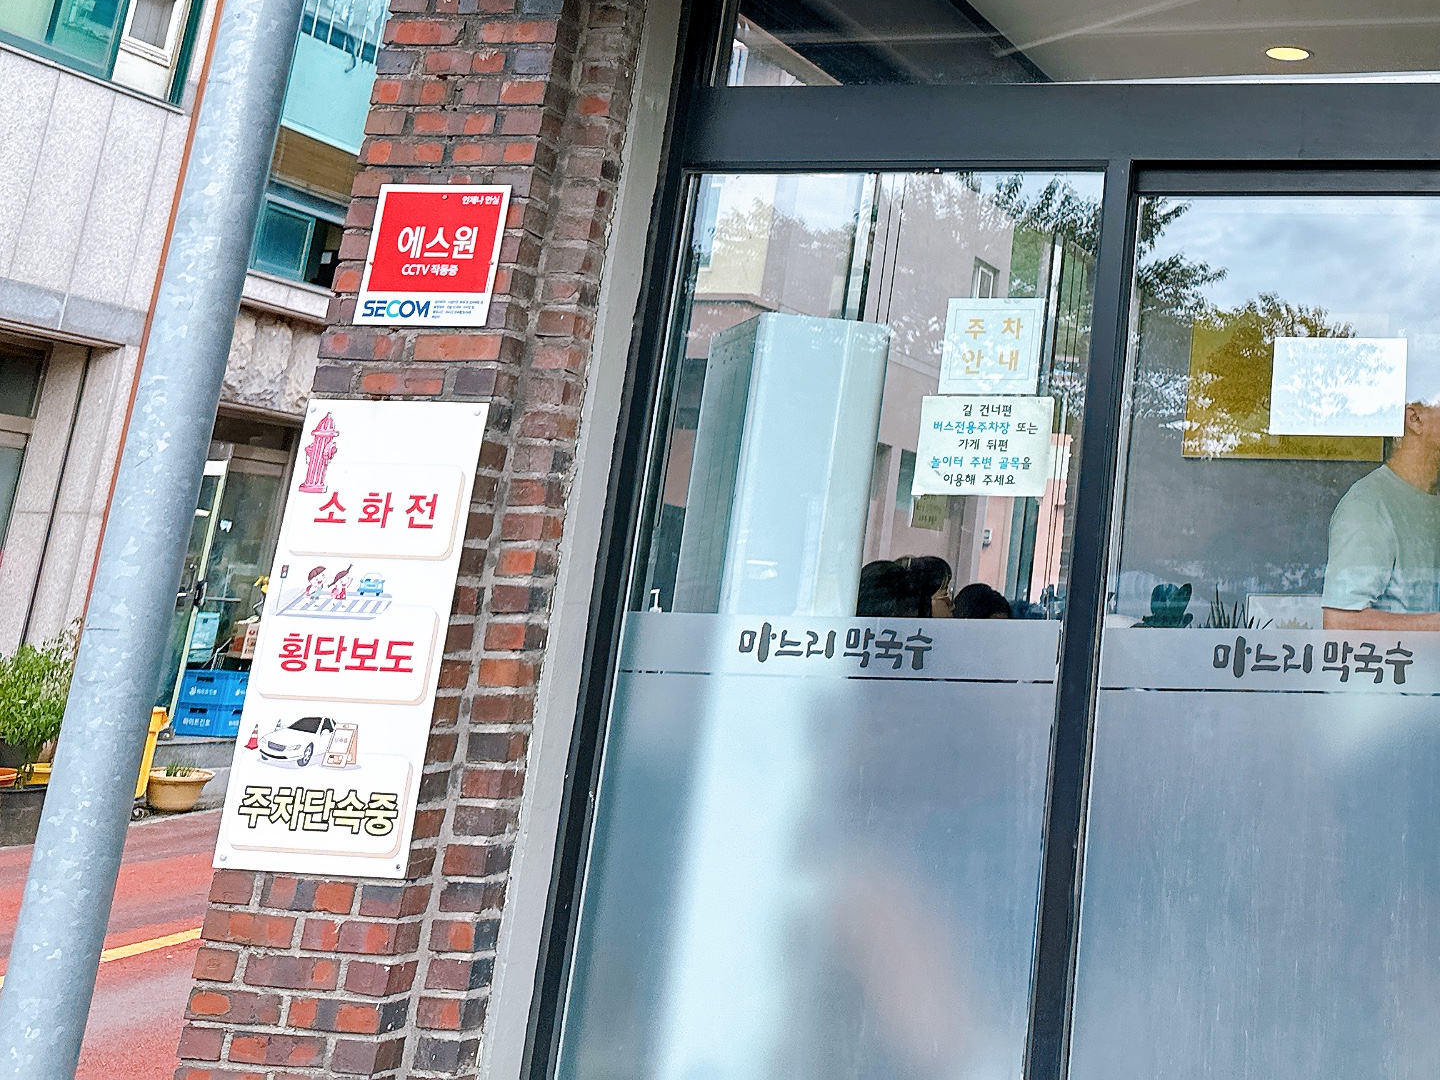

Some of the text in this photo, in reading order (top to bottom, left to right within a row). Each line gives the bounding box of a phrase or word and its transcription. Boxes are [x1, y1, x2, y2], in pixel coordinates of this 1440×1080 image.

[397, 226, 479, 259] 에스원
[401, 263, 430, 276] CCTV
[362, 299, 431, 318] SECOM
[962, 404, 1013, 417] 길 건너편
[932, 420, 1039, 435] 버스전용주차장 또는
[958, 438, 1009, 452] 가게 뒤편
[930, 455, 1032, 470] 놀이터 주변 골목을
[943, 473, 1016, 487] 이용해 주세요
[277, 632, 416, 674] 횡단보도
[738, 622, 933, 670] 마느리 막국수
[1212, 635, 1414, 685] 마느리 막국수
[237, 786, 399, 837] 주차단속중
